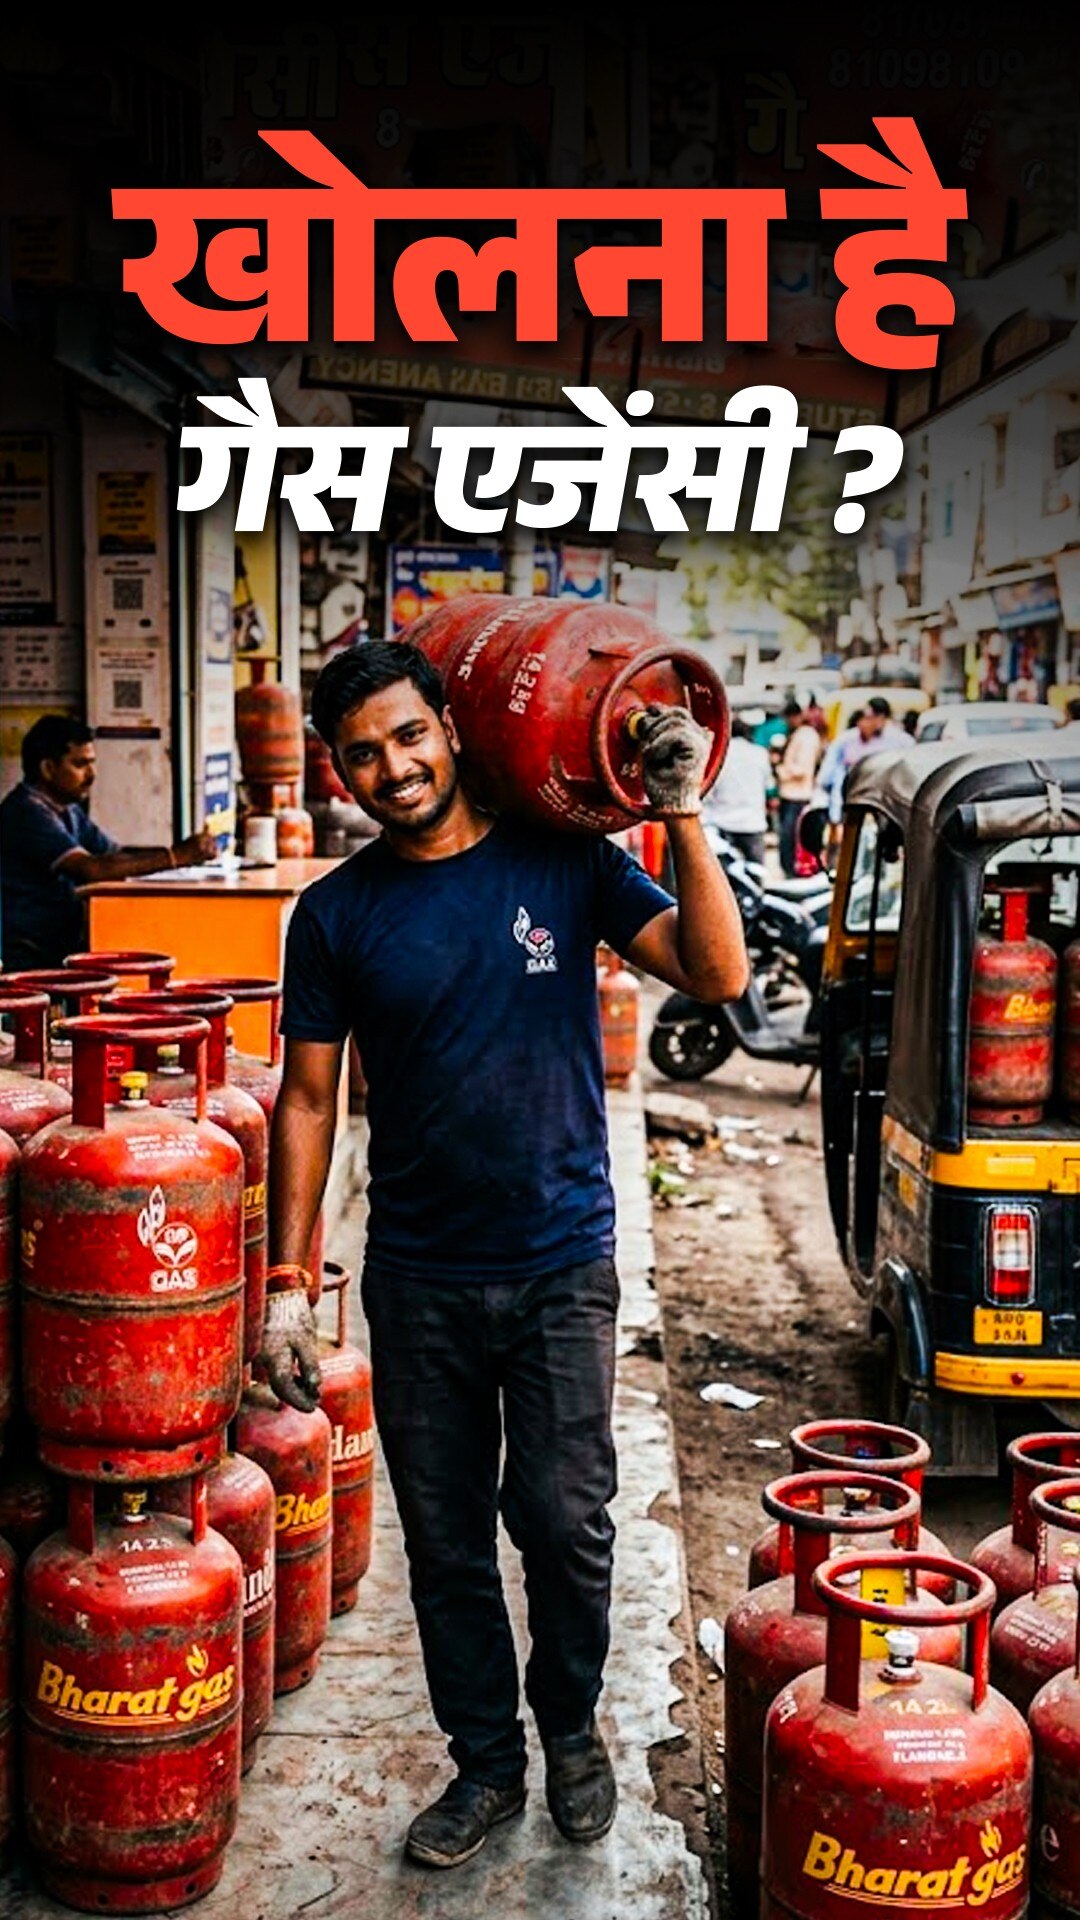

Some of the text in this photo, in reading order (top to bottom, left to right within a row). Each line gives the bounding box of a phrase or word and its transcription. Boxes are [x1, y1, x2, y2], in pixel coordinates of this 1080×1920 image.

[37, 1660, 235, 1722] Bharat gas
[802, 1831, 1026, 1906] Bharat gas
